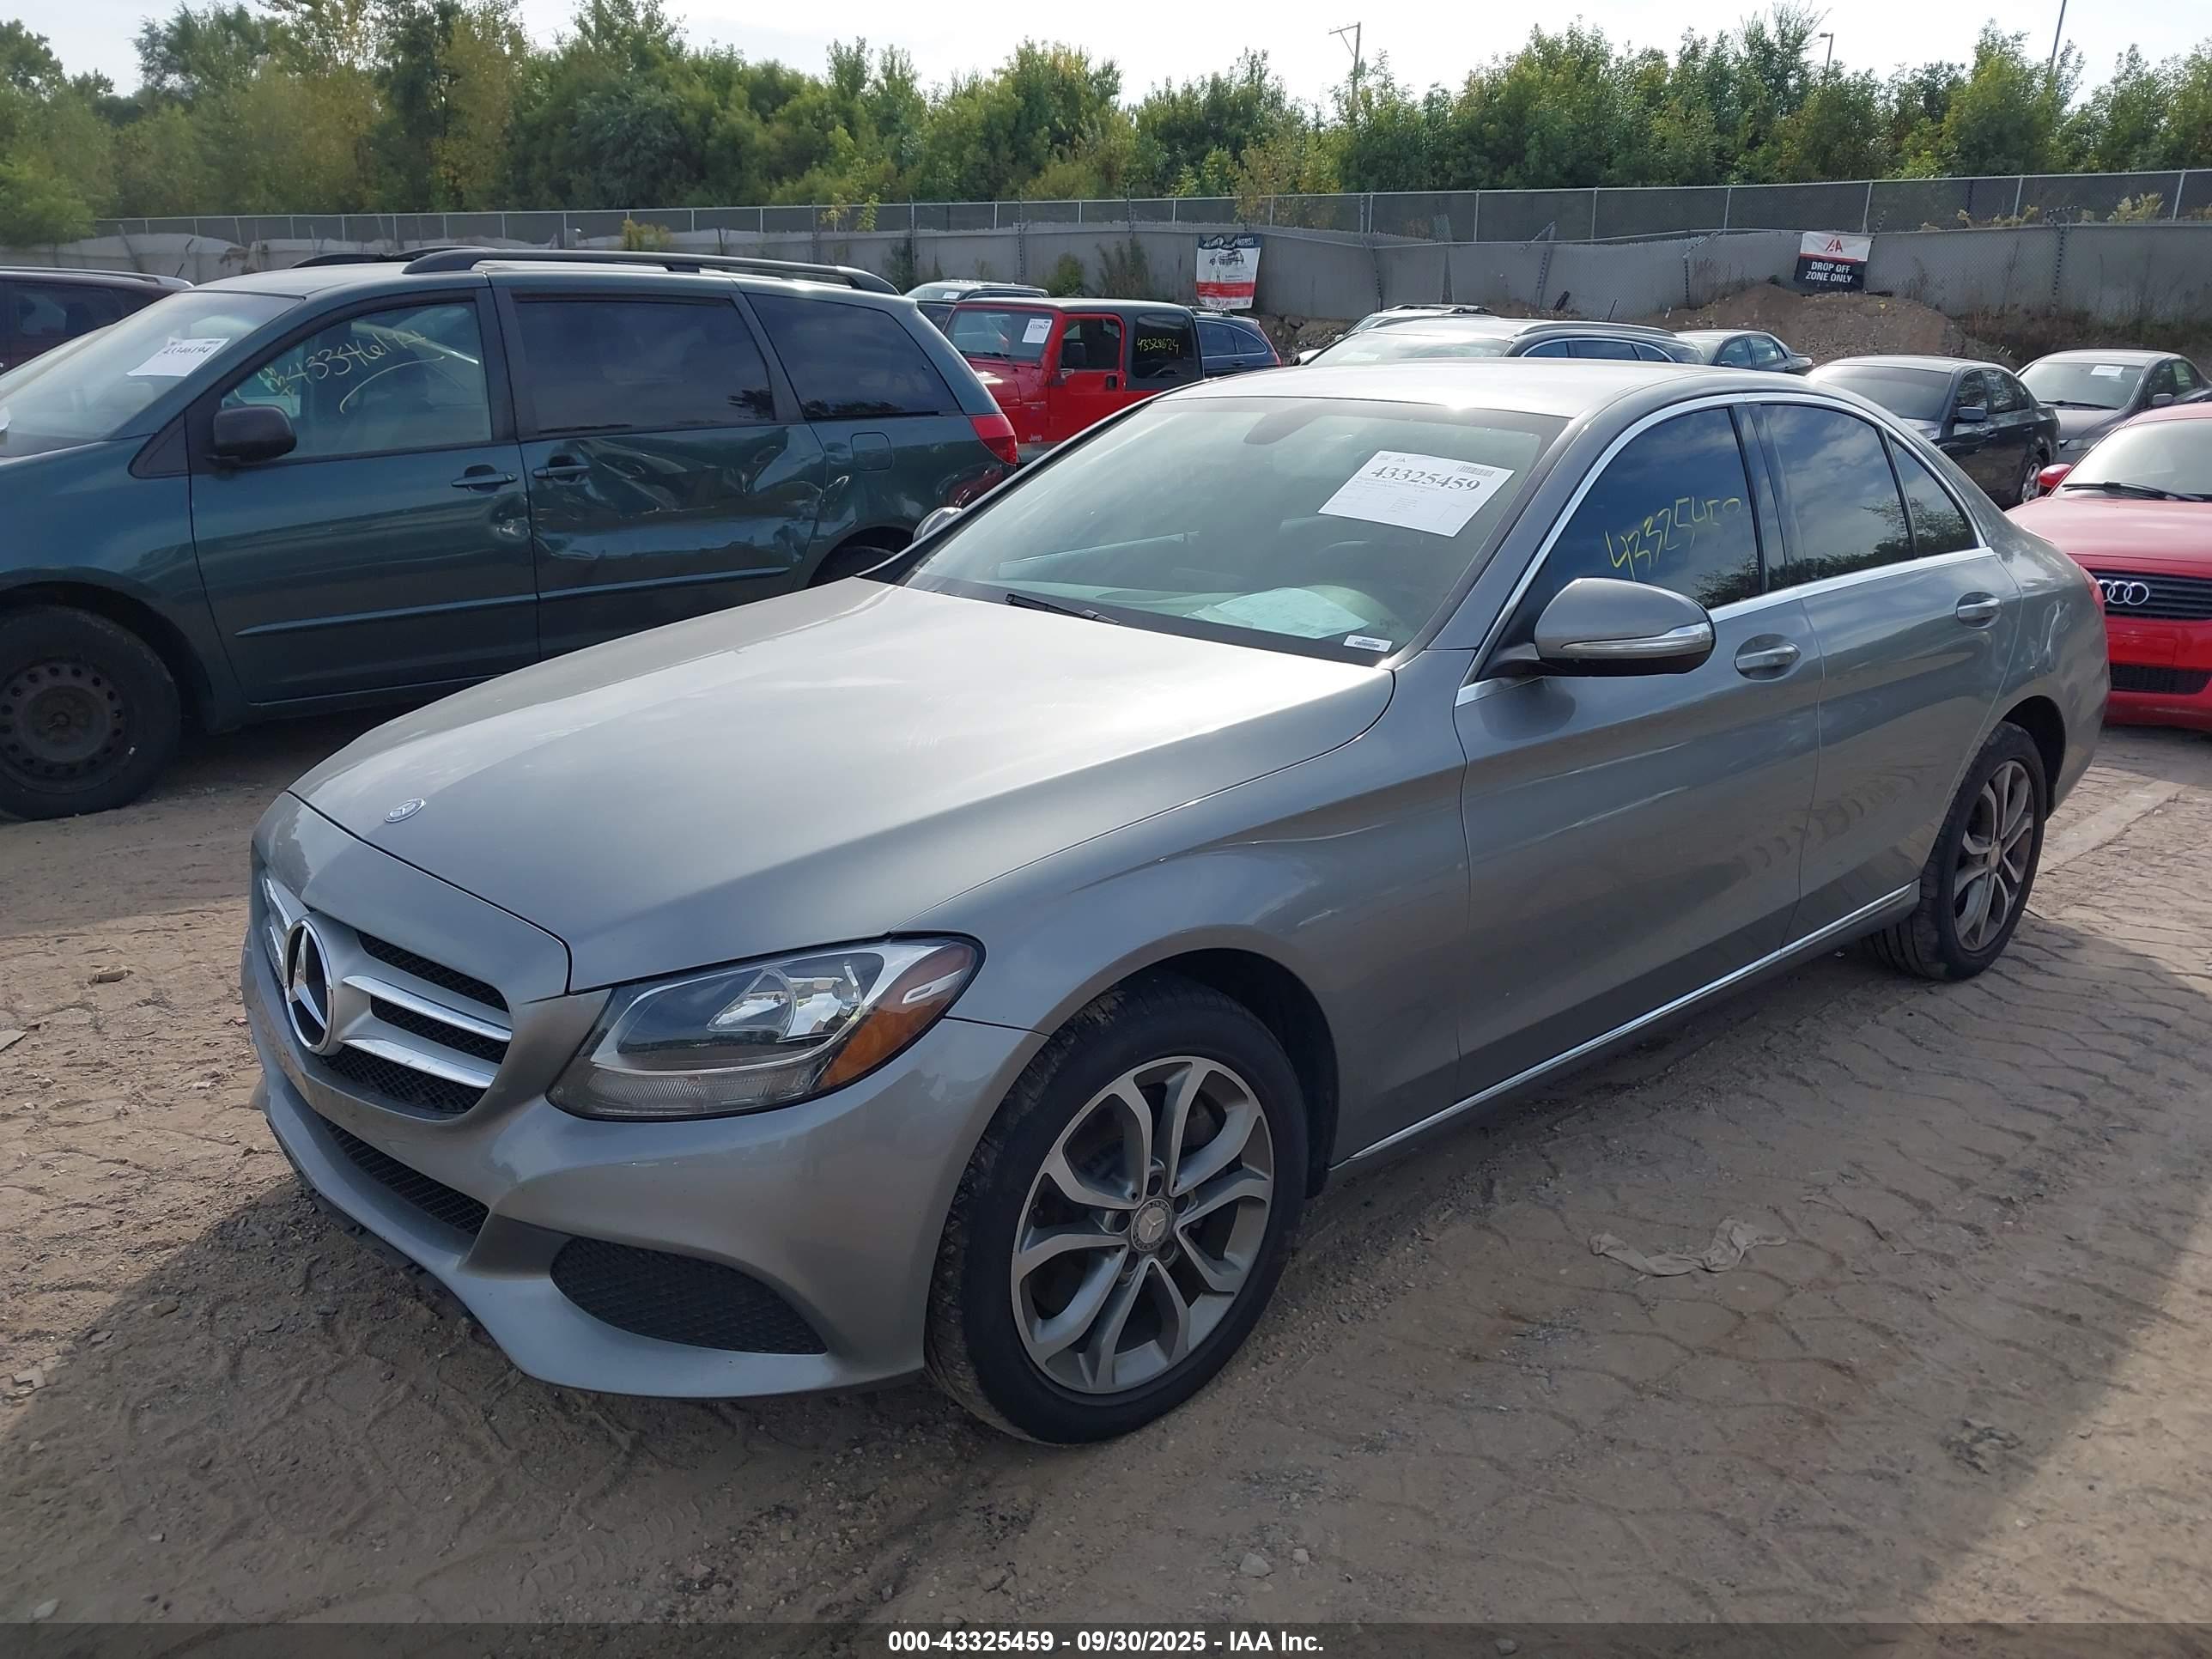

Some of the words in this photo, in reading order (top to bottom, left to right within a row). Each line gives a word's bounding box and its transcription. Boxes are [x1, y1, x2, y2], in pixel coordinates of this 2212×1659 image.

[1811, 260, 1834, 271] DROP
[1836, 264, 1850, 273] OFF
[1805, 270, 1829, 282] ZONE
[1830, 273, 1853, 283] ONLY
[1029, 433, 1042, 441] Jeep
[1370, 465, 1481, 492] 43325459
